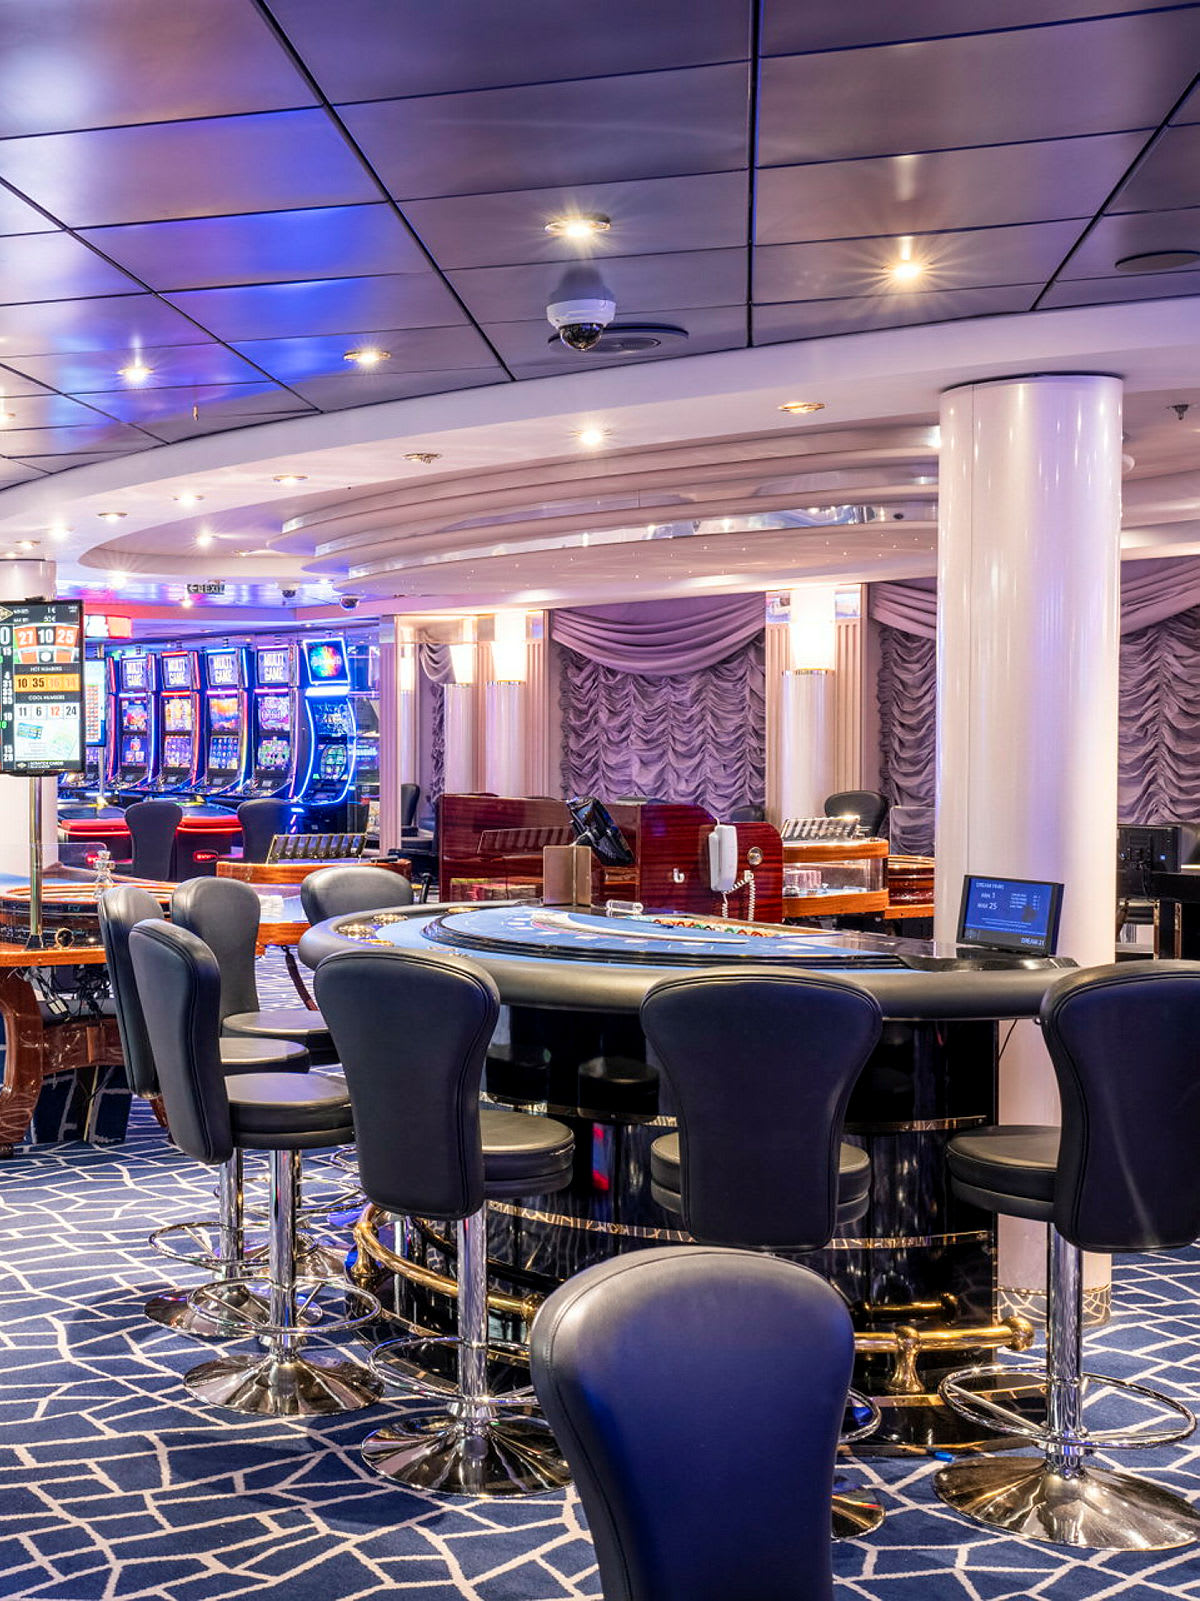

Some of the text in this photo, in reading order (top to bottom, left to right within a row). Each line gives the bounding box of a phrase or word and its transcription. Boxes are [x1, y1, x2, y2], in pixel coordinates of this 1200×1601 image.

[18, 629, 74, 645] 27 10 25
[264, 653, 283, 666] MULTI
[264, 667, 283, 680] GAME
[18, 679, 27, 688] 10
[32, 678, 44, 688] 35
[19, 706, 77, 716] 11 6 12 24
